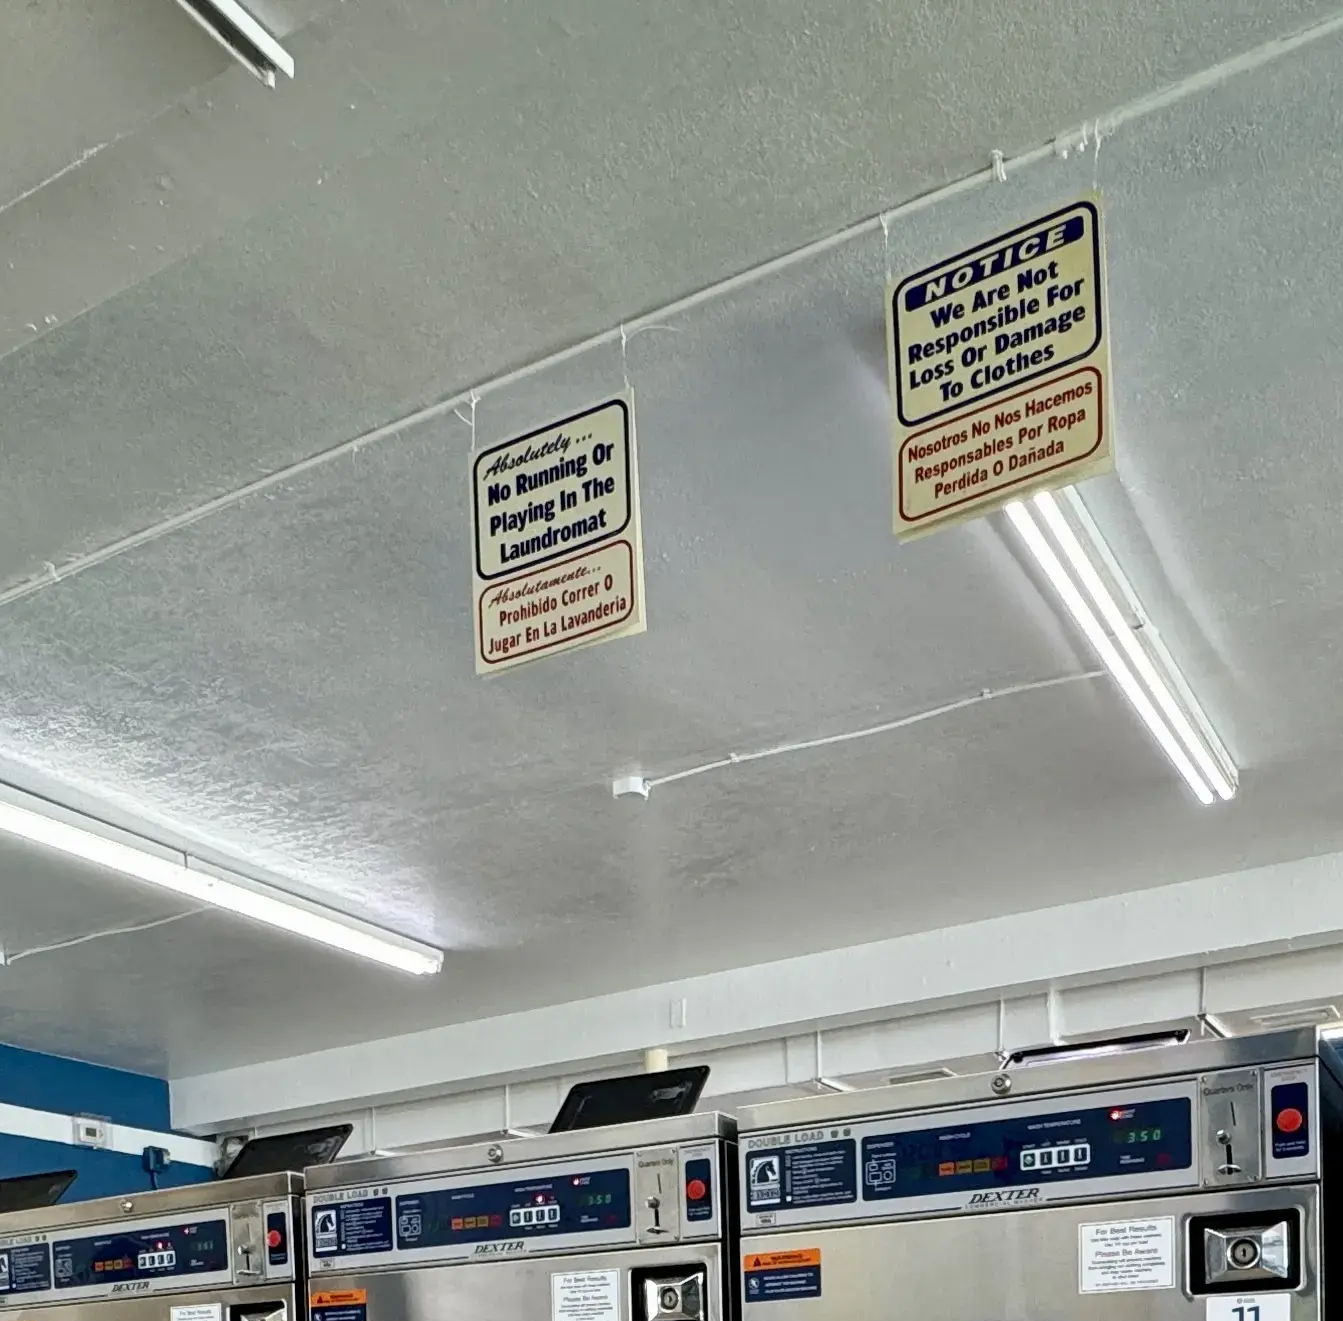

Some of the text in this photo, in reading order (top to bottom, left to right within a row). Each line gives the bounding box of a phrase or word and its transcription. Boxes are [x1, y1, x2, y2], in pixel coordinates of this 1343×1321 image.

[924, 223, 1067, 303] NOTICE
[908, 279, 1085, 365] Responsible For
[930, 261, 1060, 328] We Are Not
[909, 306, 1086, 390] Loss Or Damage
[939, 343, 1055, 402] To Clothes
[908, 380, 1093, 463] Nosotros No Nos Hacemos
[915, 408, 1086, 484] Responsables Por Ropa
[488, 442, 615, 506] No Running Or
[934, 439, 1065, 499] Perdida O Dañada
[490, 476, 615, 537] Playing In The
[500, 508, 607, 564] Laundromat
[500, 574, 613, 627] Prohibido Correr O
[488, 633, 521, 655] Jugar
[526, 626, 540, 643] En
[543, 620, 557, 637] La
[1203, 1086, 1235, 1096] Quarters
[748, 1131, 824, 1149] DOUBLE LOAD
[313, 1190, 368, 1203] DOUBLE LOAD
[968, 1187, 1040, 1204] DEXTER
[474, 1241, 525, 1255] DEXTER
[112, 1281, 150, 1293] DEXTER
